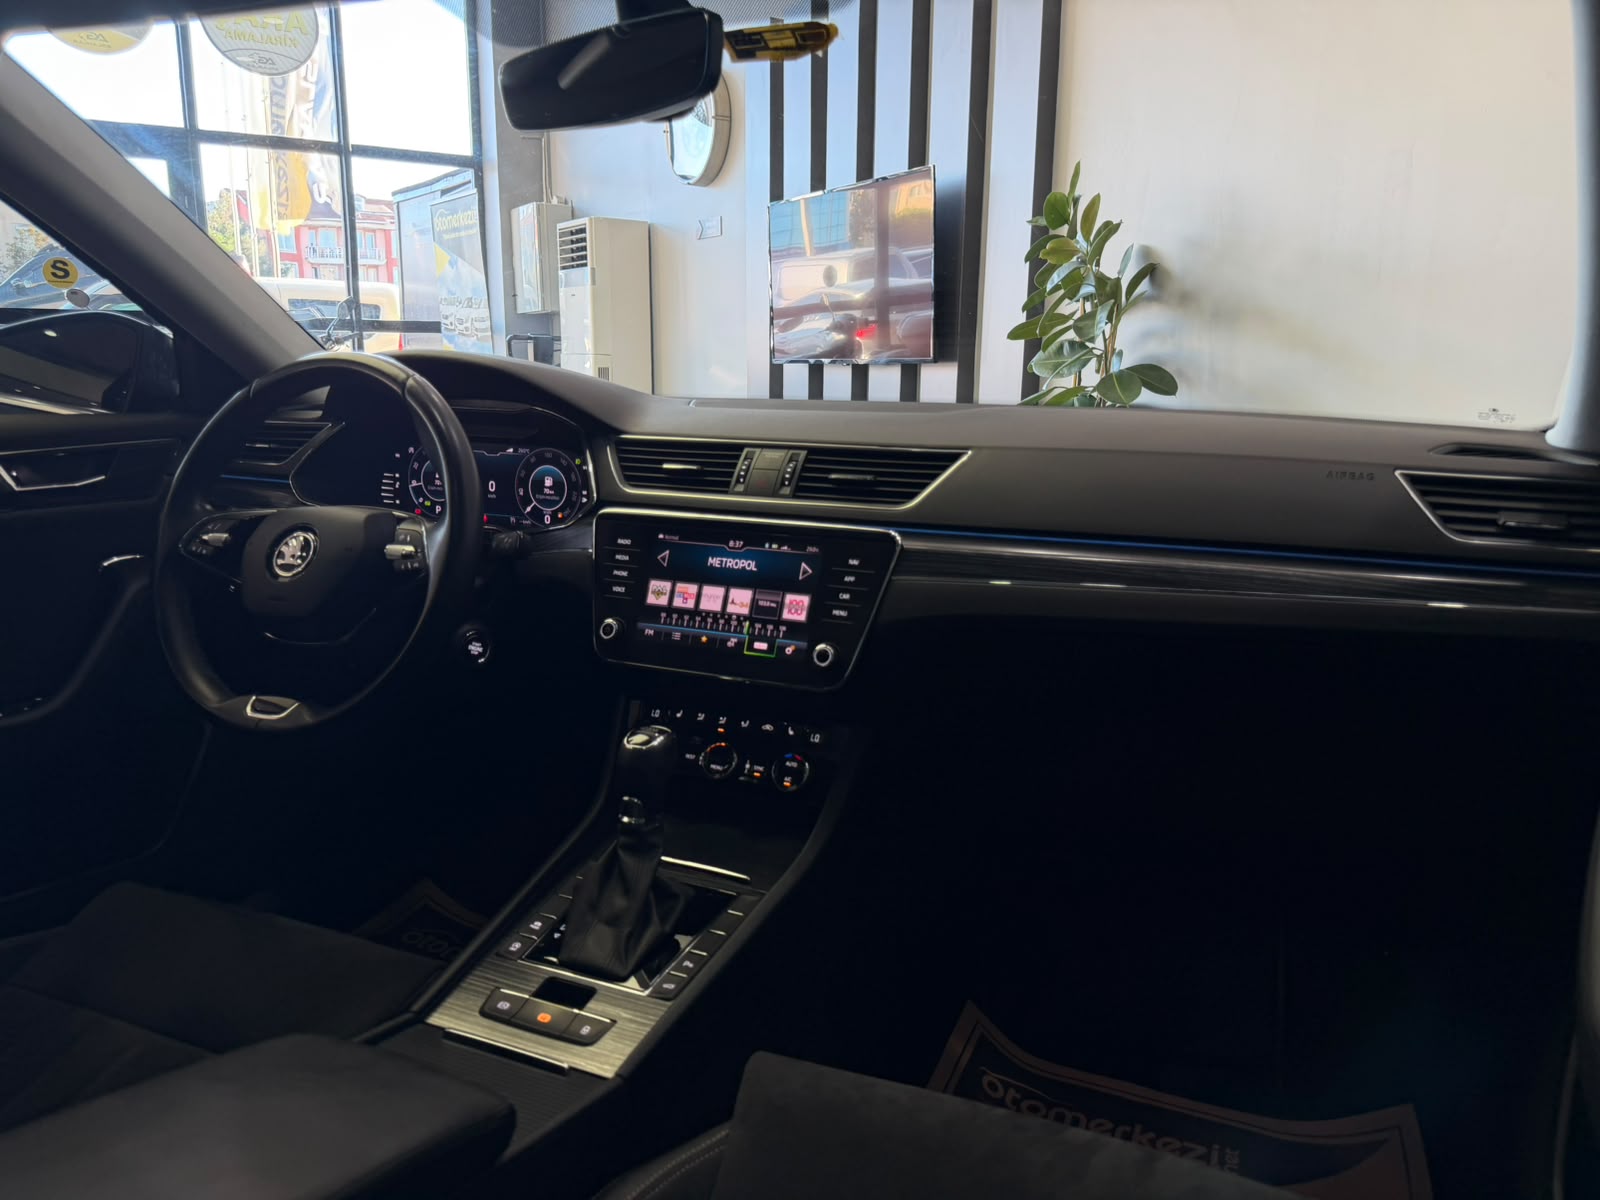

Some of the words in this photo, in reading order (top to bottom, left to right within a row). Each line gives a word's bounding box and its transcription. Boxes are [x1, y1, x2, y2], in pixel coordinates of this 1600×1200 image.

[50, 259, 71, 280] S
[1326, 470, 1375, 481] AIRBAG
[488, 480, 496, 492] 0
[435, 504, 442, 515] P
[544, 514, 551, 524] 0
[616, 537, 632, 545] RADIO
[706, 556, 758, 571] METROPOL
[847, 558, 860, 566] NAV
[612, 569, 629, 577] PHONE
[611, 585, 626, 593] VOICE
[838, 592, 851, 600] CAR
[832, 609, 848, 617] MENU
